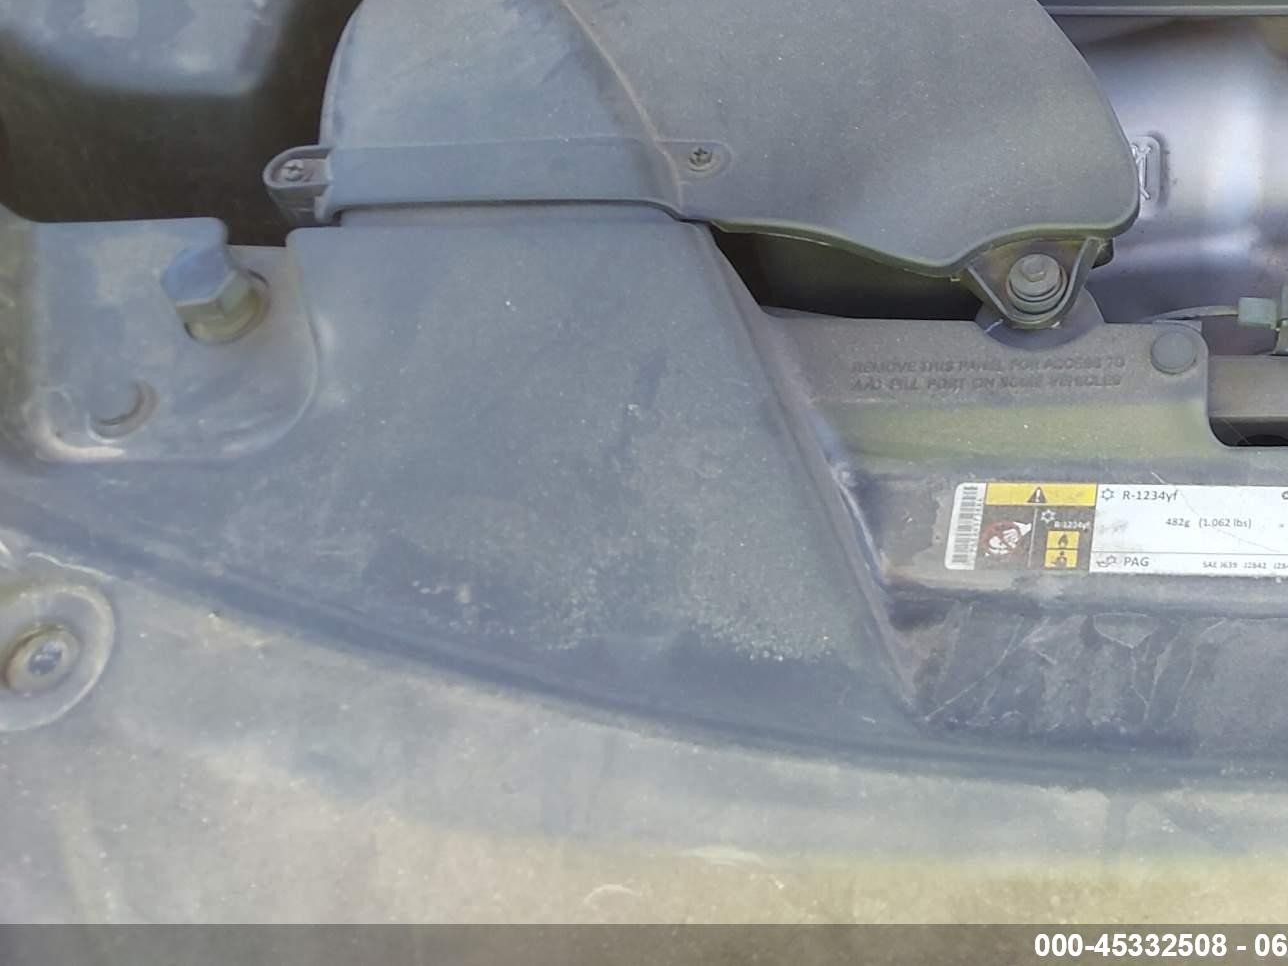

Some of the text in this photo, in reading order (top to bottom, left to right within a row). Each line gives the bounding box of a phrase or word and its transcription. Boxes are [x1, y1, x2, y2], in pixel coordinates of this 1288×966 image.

[1122, 489, 1179, 502] R-1234yf
[1166, 517, 1252, 529] 482g (1.062 lbs)
[1123, 556, 1150, 568] PAG
